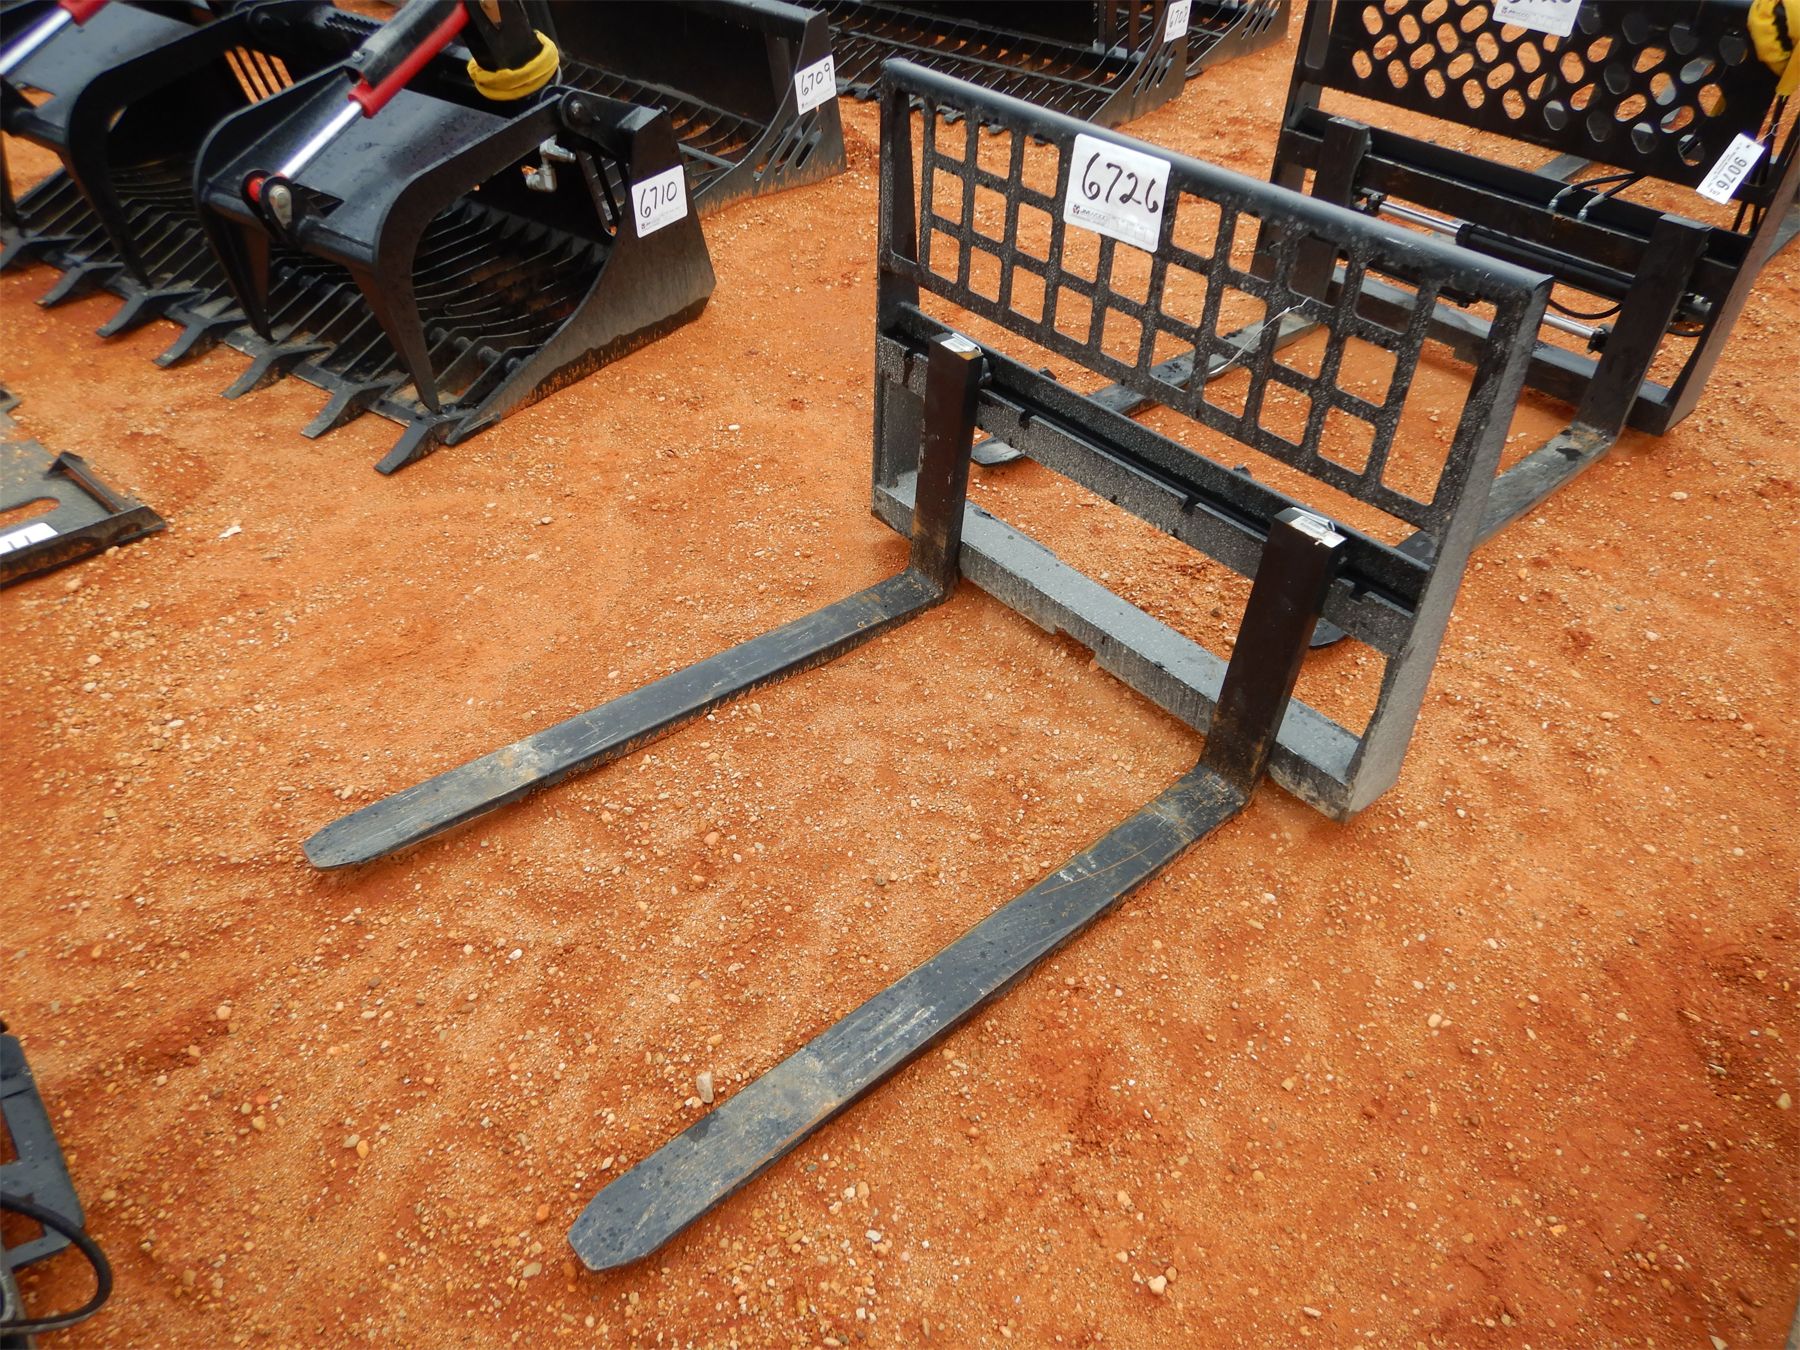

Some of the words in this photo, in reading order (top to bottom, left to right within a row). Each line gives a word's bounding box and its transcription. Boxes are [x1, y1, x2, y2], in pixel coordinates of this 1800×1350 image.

[801, 62, 832, 96] 6709
[1082, 152, 1159, 213] 6726
[1715, 156, 1748, 191] 9076
[640, 181, 678, 219] 6710
